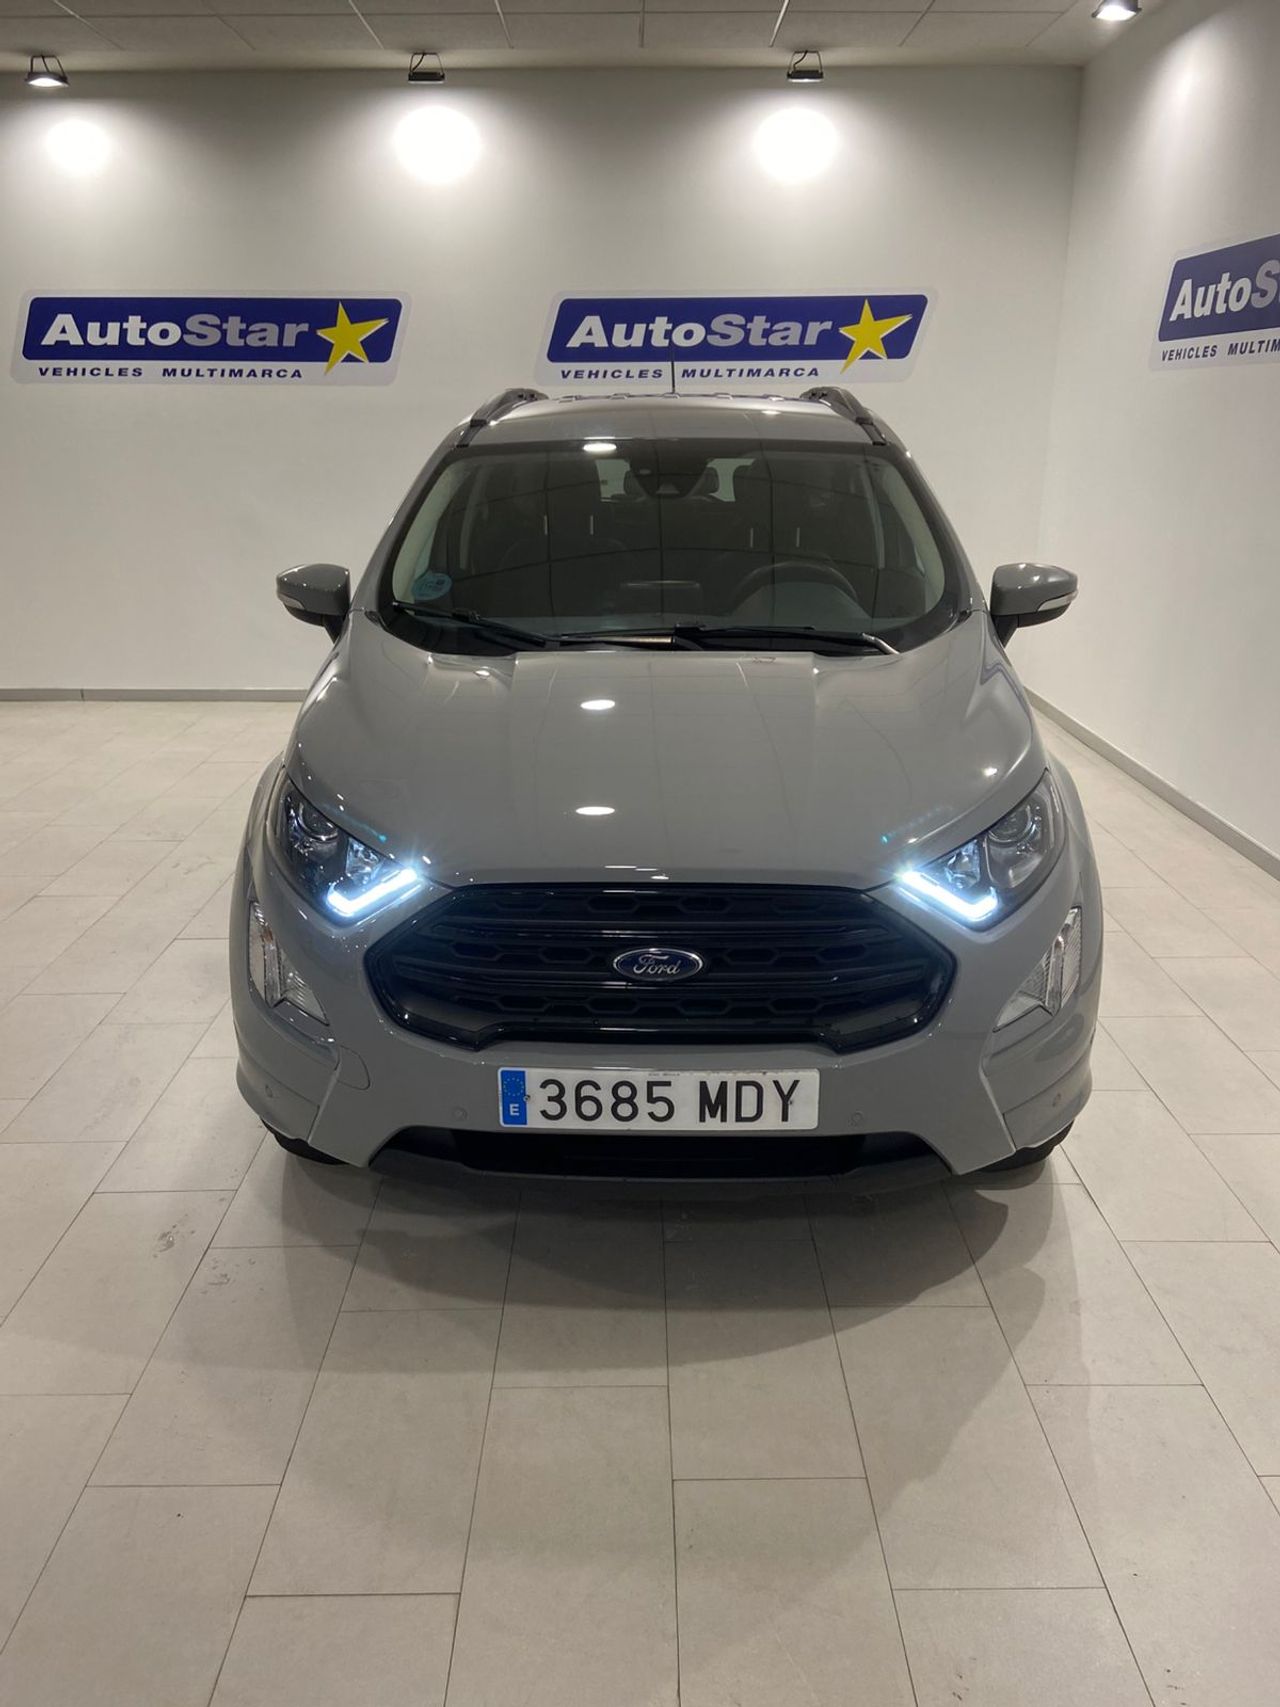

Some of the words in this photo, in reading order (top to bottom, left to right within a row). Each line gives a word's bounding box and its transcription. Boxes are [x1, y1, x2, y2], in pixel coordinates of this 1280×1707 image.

[1169, 259, 1280, 322] AutoS
[41, 313, 309, 347] AutoStar
[566, 313, 832, 348] AutoStar
[1161, 345, 1218, 361] VEHICLES
[38, 367, 143, 377] VEHICLES
[162, 367, 303, 379] MULTIMARCA
[560, 369, 664, 379] VEHICLES
[681, 367, 819, 378] MULTIMARCA
[632, 953, 680, 975] Ford
[509, 1103, 520, 1116] E
[539, 1079, 675, 1122] 3685
[698, 1079, 800, 1123] MDY
